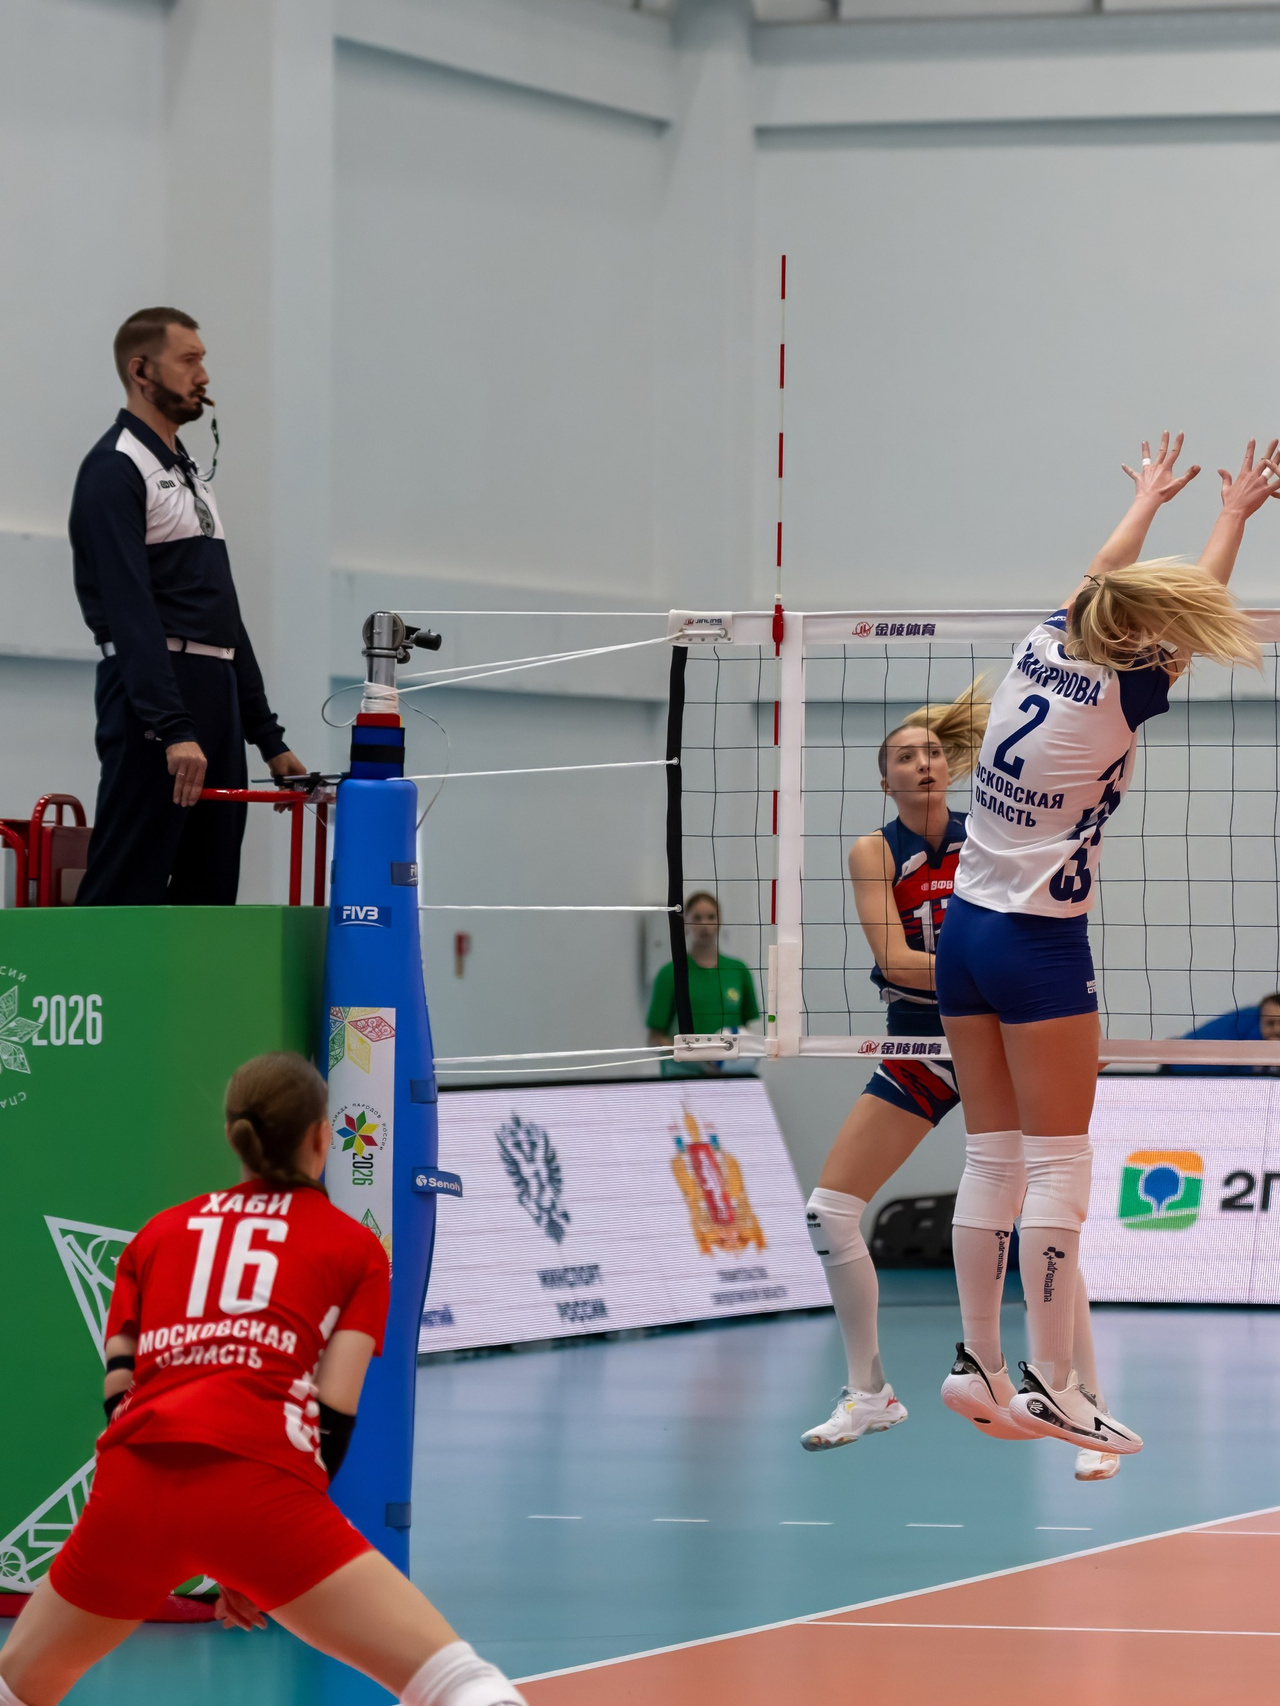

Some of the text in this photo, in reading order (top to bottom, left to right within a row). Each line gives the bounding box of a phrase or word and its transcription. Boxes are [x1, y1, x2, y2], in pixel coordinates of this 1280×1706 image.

[875, 623, 936, 637] 金陵体育
[993, 694, 1050, 780] 2
[976, 761, 1064, 809] ОСКОВСКАЯ
[975, 785, 1036, 827] ОБЛАСТЬ
[343, 906, 379, 920] FIVB
[32, 994, 103, 1046] 2026
[881, 1042, 942, 1055] 金陵体育
[352, 1153, 374, 1186] 2026
[428, 1178, 461, 1191] Senoh
[200, 1192, 292, 1216] ХАБИ
[185, 1216, 289, 1318] 16
[138, 1318, 297, 1356] МОСКОВСКАЯ
[155, 1343, 263, 1370] ОБЛАСТЬ
